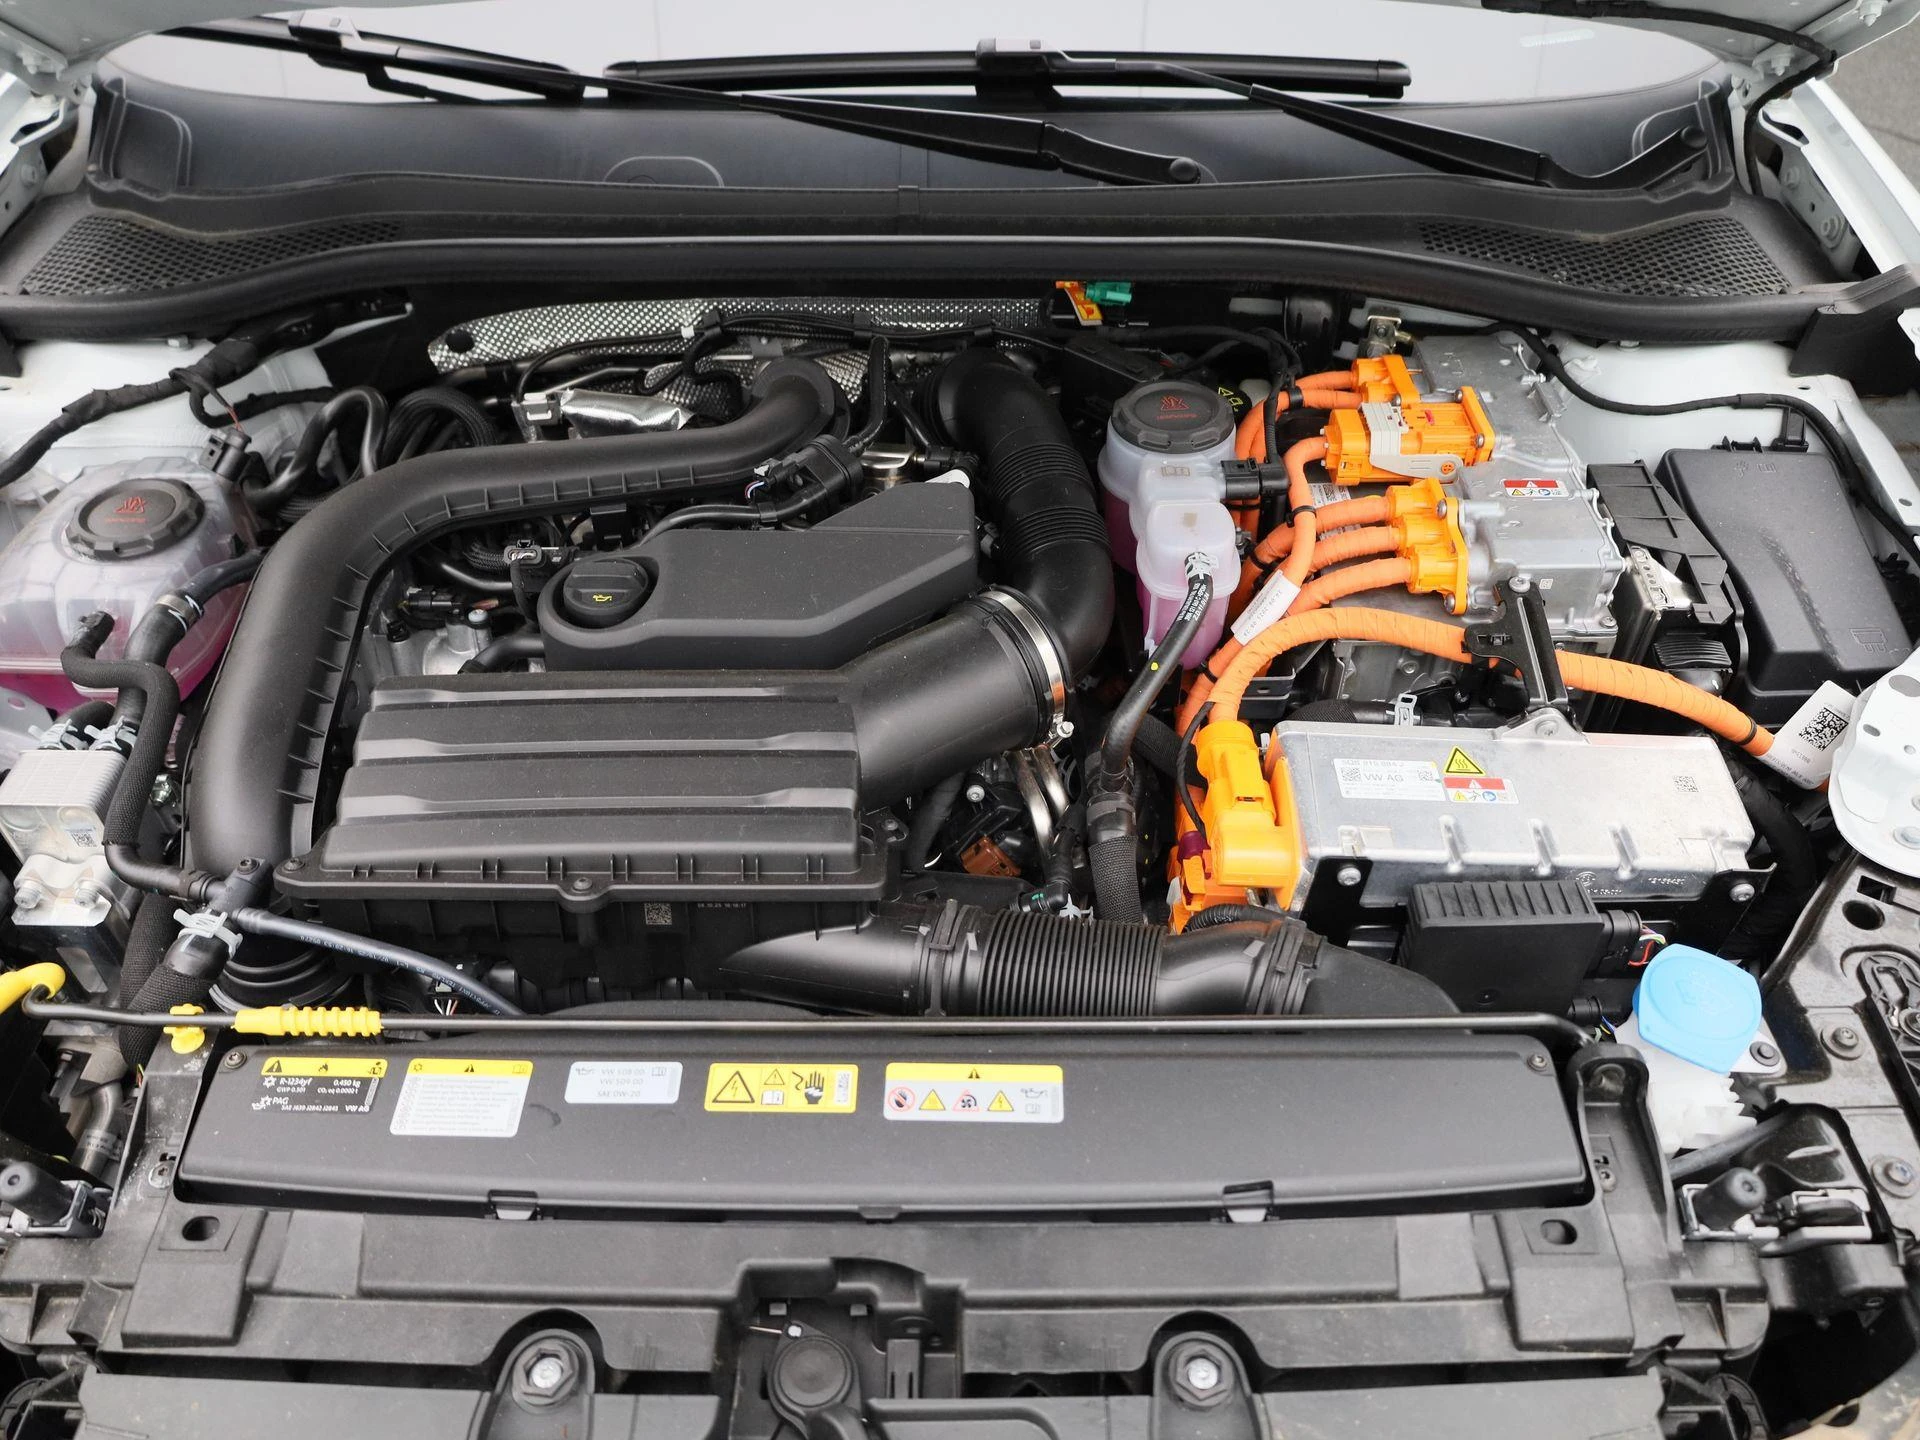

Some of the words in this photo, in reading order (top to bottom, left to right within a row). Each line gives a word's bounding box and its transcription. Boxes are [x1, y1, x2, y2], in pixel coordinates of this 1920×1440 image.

[1364, 773, 1382, 781] VW
[1387, 774, 1404, 782] AG
[279, 1077, 313, 1086] R-1234yf
[352, 1079, 361, 1088] kg
[272, 1097, 289, 1105] PAG
[345, 1105, 358, 1113] VW
[358, 1105, 370, 1113] AG
